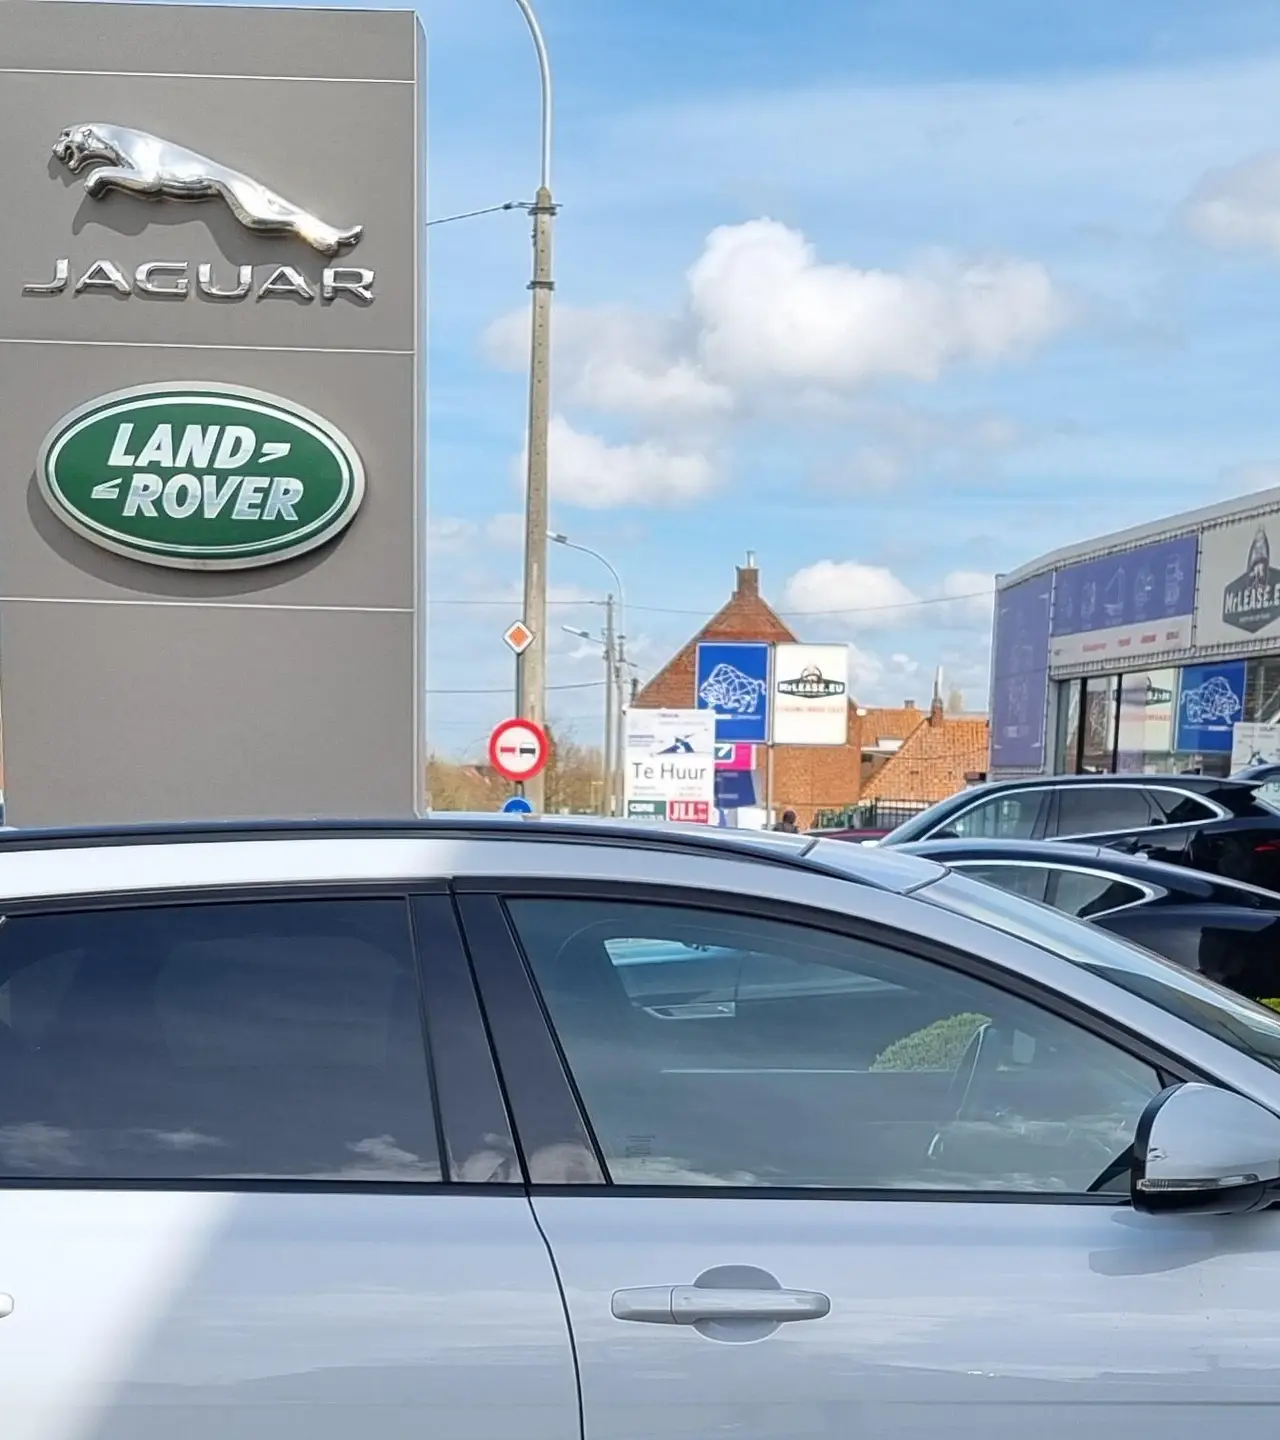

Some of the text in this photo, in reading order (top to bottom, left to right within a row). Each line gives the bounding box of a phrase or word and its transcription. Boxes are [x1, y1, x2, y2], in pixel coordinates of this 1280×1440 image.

[23, 258, 376, 300] JAGUAR
[107, 422, 257, 469] LAND
[121, 473, 305, 520] ROVER
[632, 762, 707, 780] Te Huur
